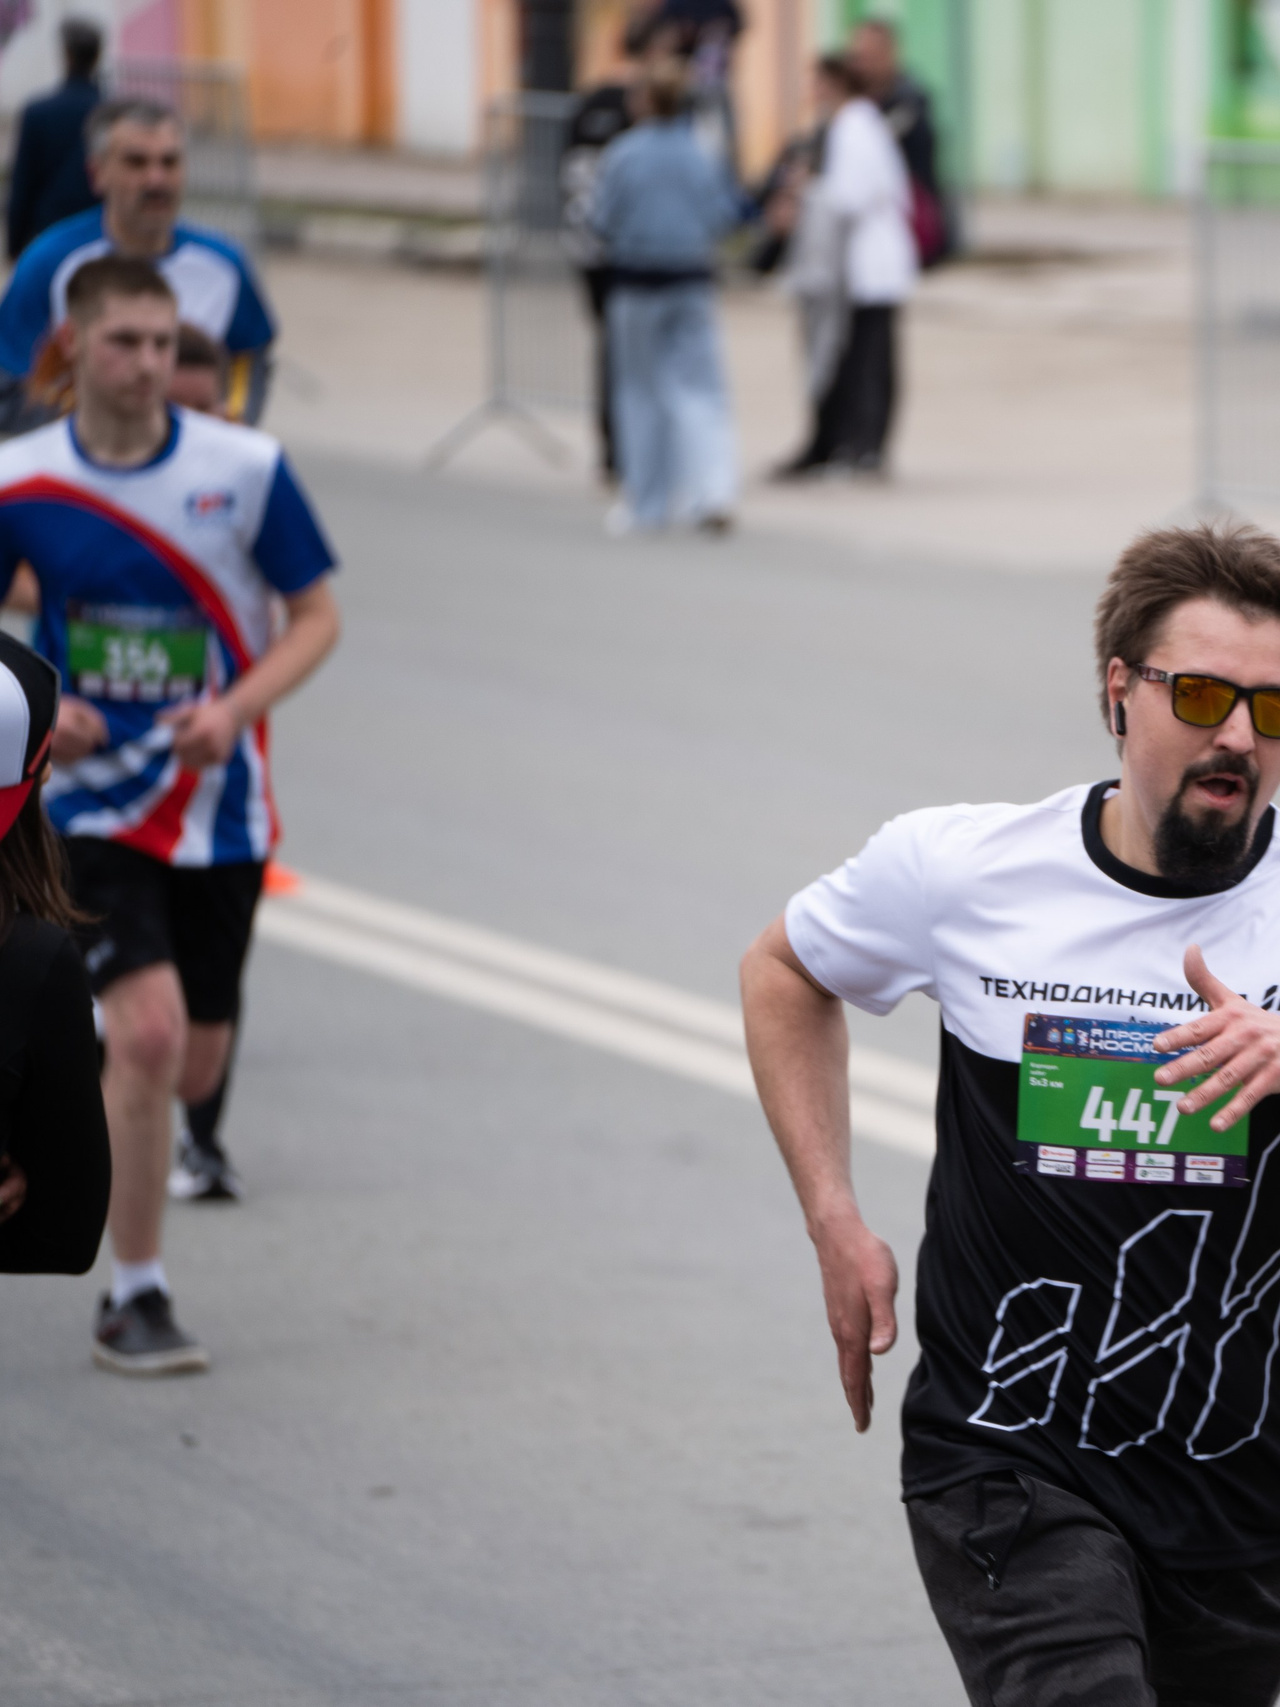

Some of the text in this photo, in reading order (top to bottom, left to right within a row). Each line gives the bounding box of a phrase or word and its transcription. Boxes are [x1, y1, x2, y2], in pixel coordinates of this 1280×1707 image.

[980, 975, 1247, 1012] ТЕХНОДИНАМИ
[1105, 1029, 1157, 1042] ПРОС
[1080, 1085, 1187, 1145] 447
